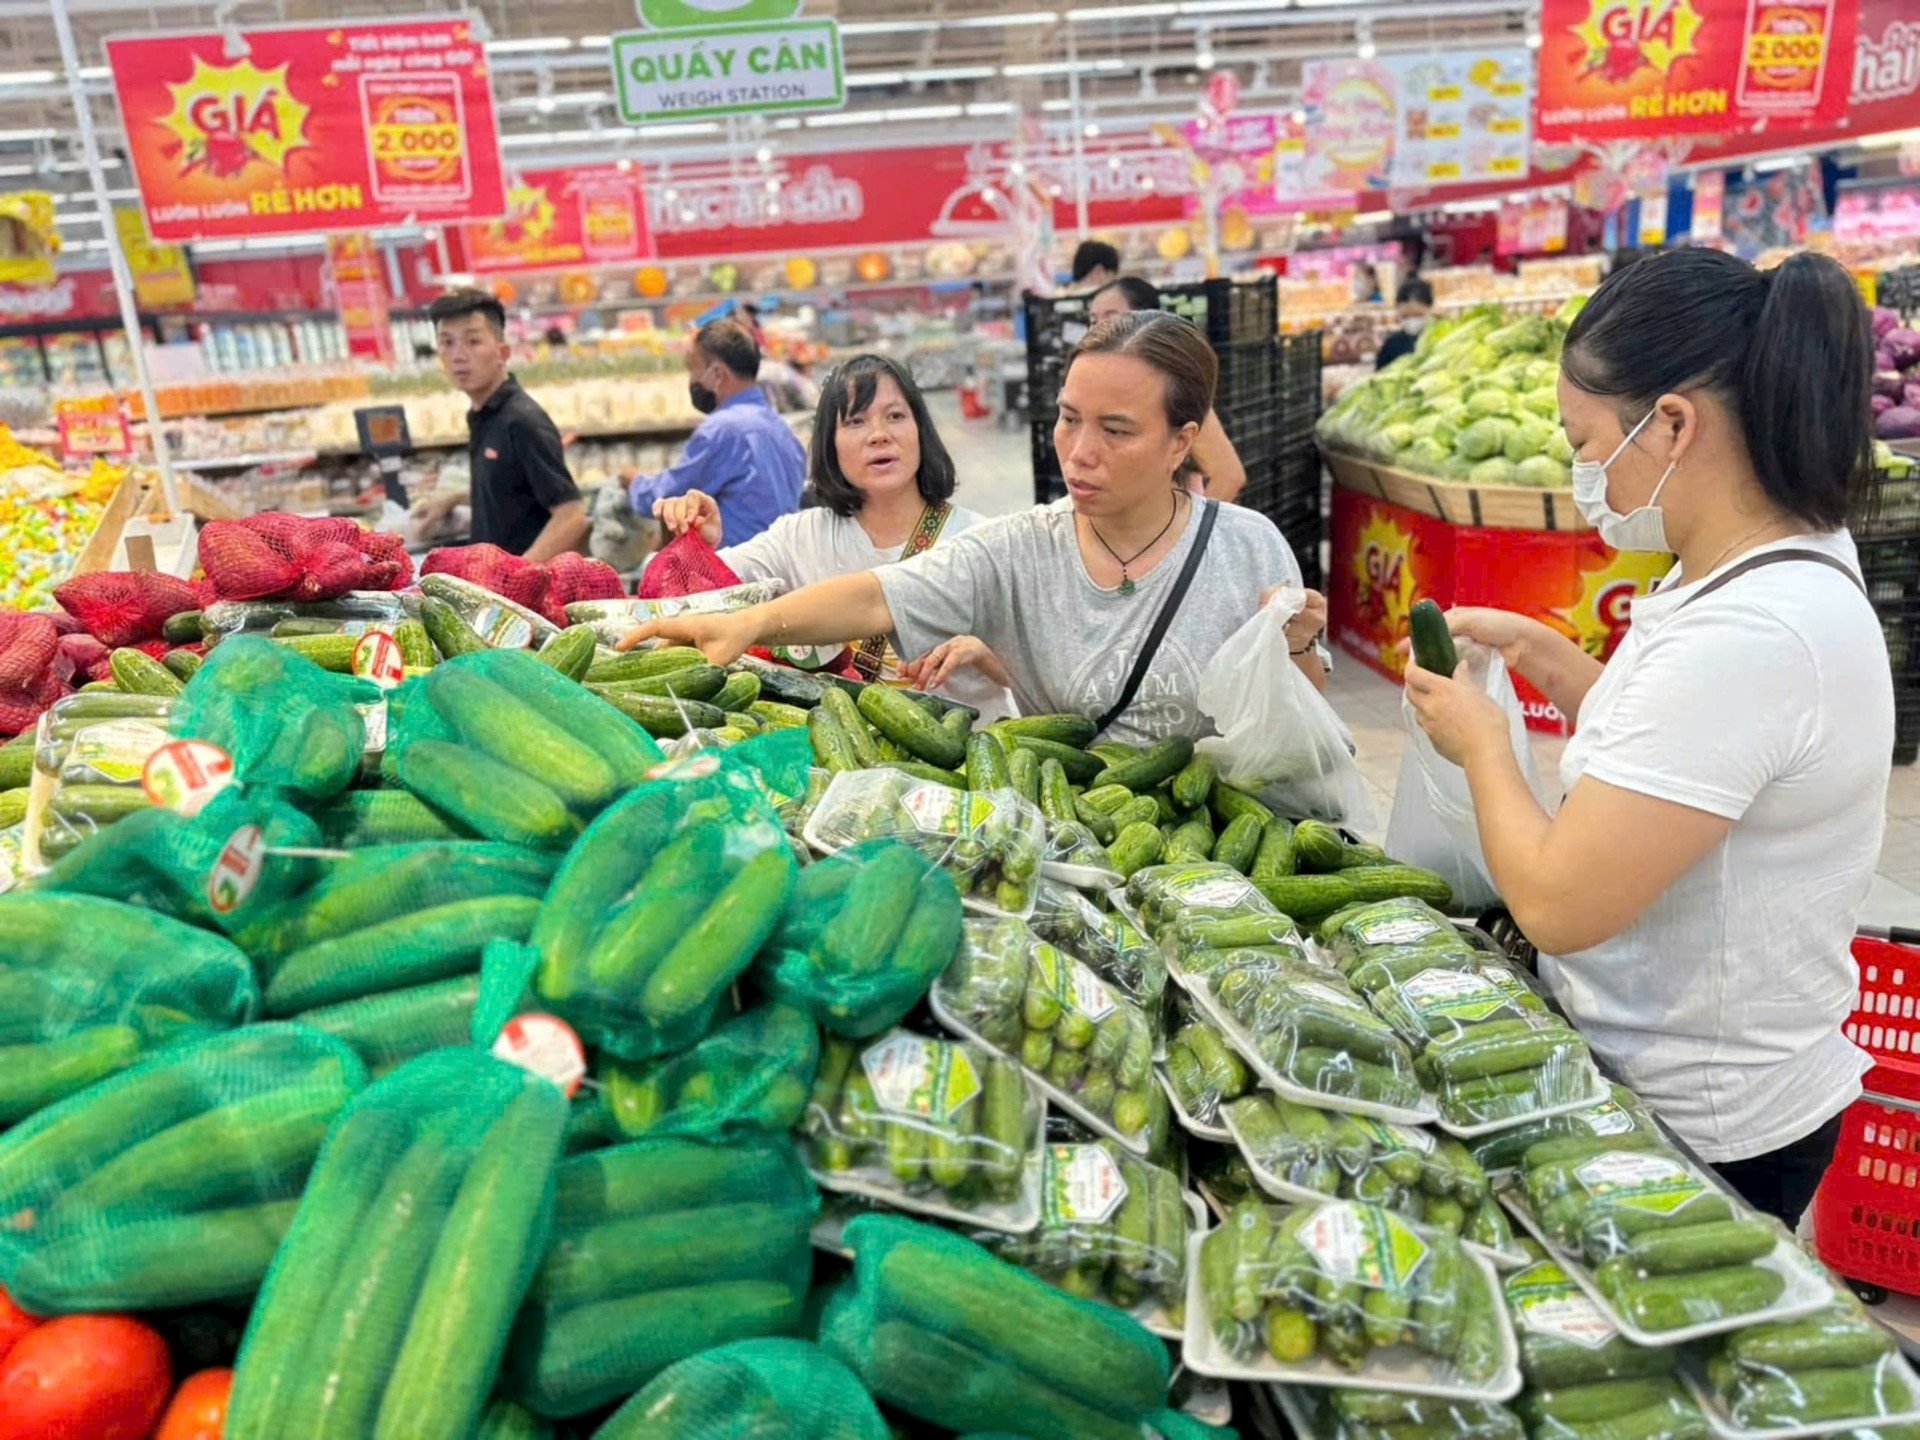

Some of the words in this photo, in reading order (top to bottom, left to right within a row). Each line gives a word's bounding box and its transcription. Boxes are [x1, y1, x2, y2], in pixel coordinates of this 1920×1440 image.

[747, 37, 827, 74] CÂN
[658, 90, 723, 108] WEIGH
[728, 84, 807, 103] STATION
[188, 88, 282, 141] GIÁ
[293, 183, 363, 212] HƠN
